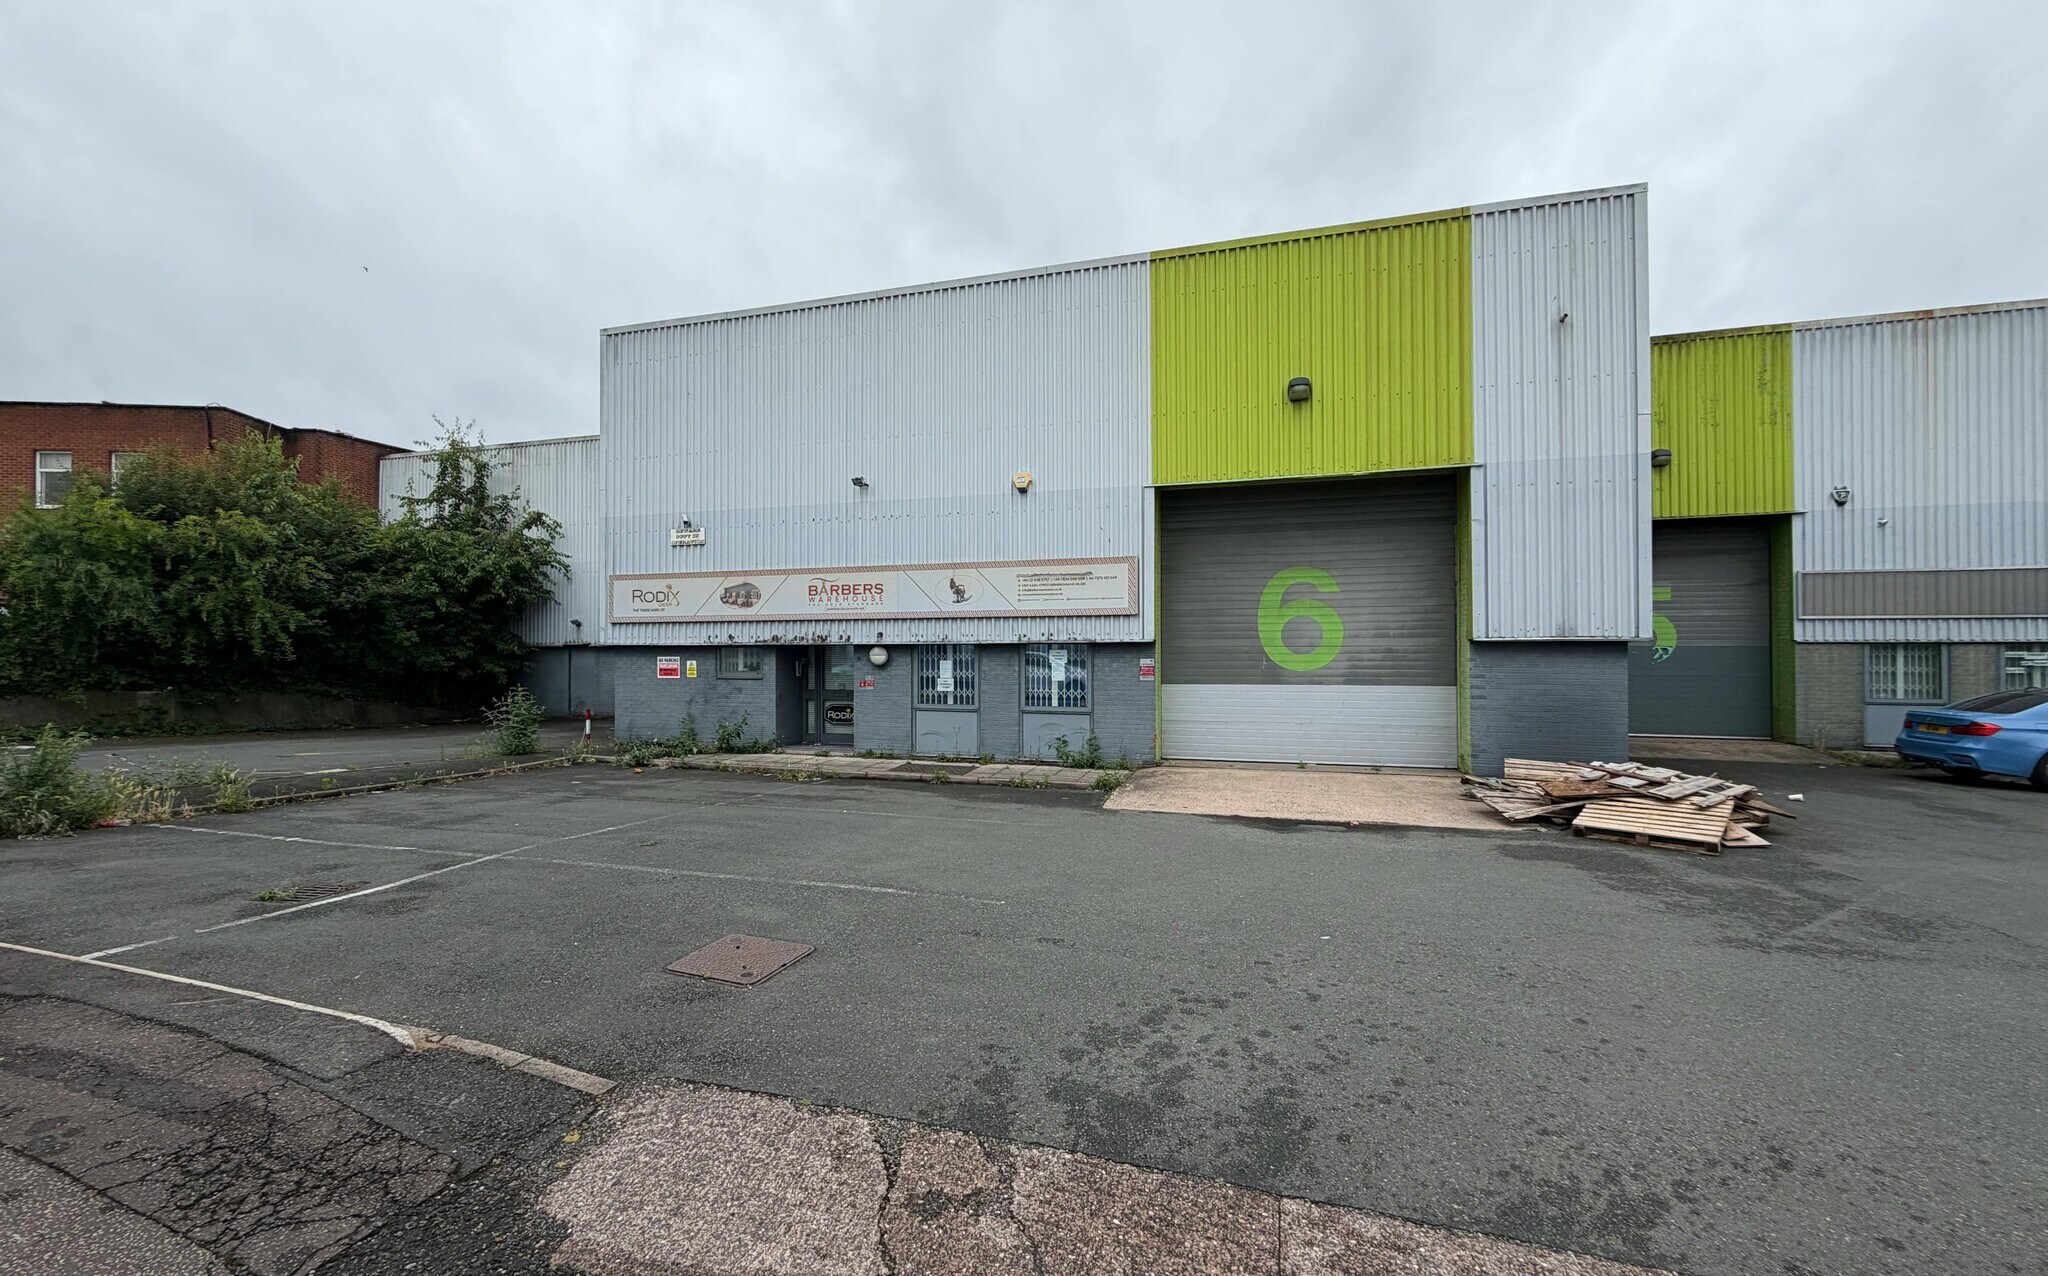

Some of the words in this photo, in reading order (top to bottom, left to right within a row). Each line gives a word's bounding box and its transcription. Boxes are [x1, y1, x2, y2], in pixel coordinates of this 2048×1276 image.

[808, 580, 884, 596] BARBERS
[808, 595, 884, 603] WAREHOUSE
[1257, 566, 1344, 672] 6
